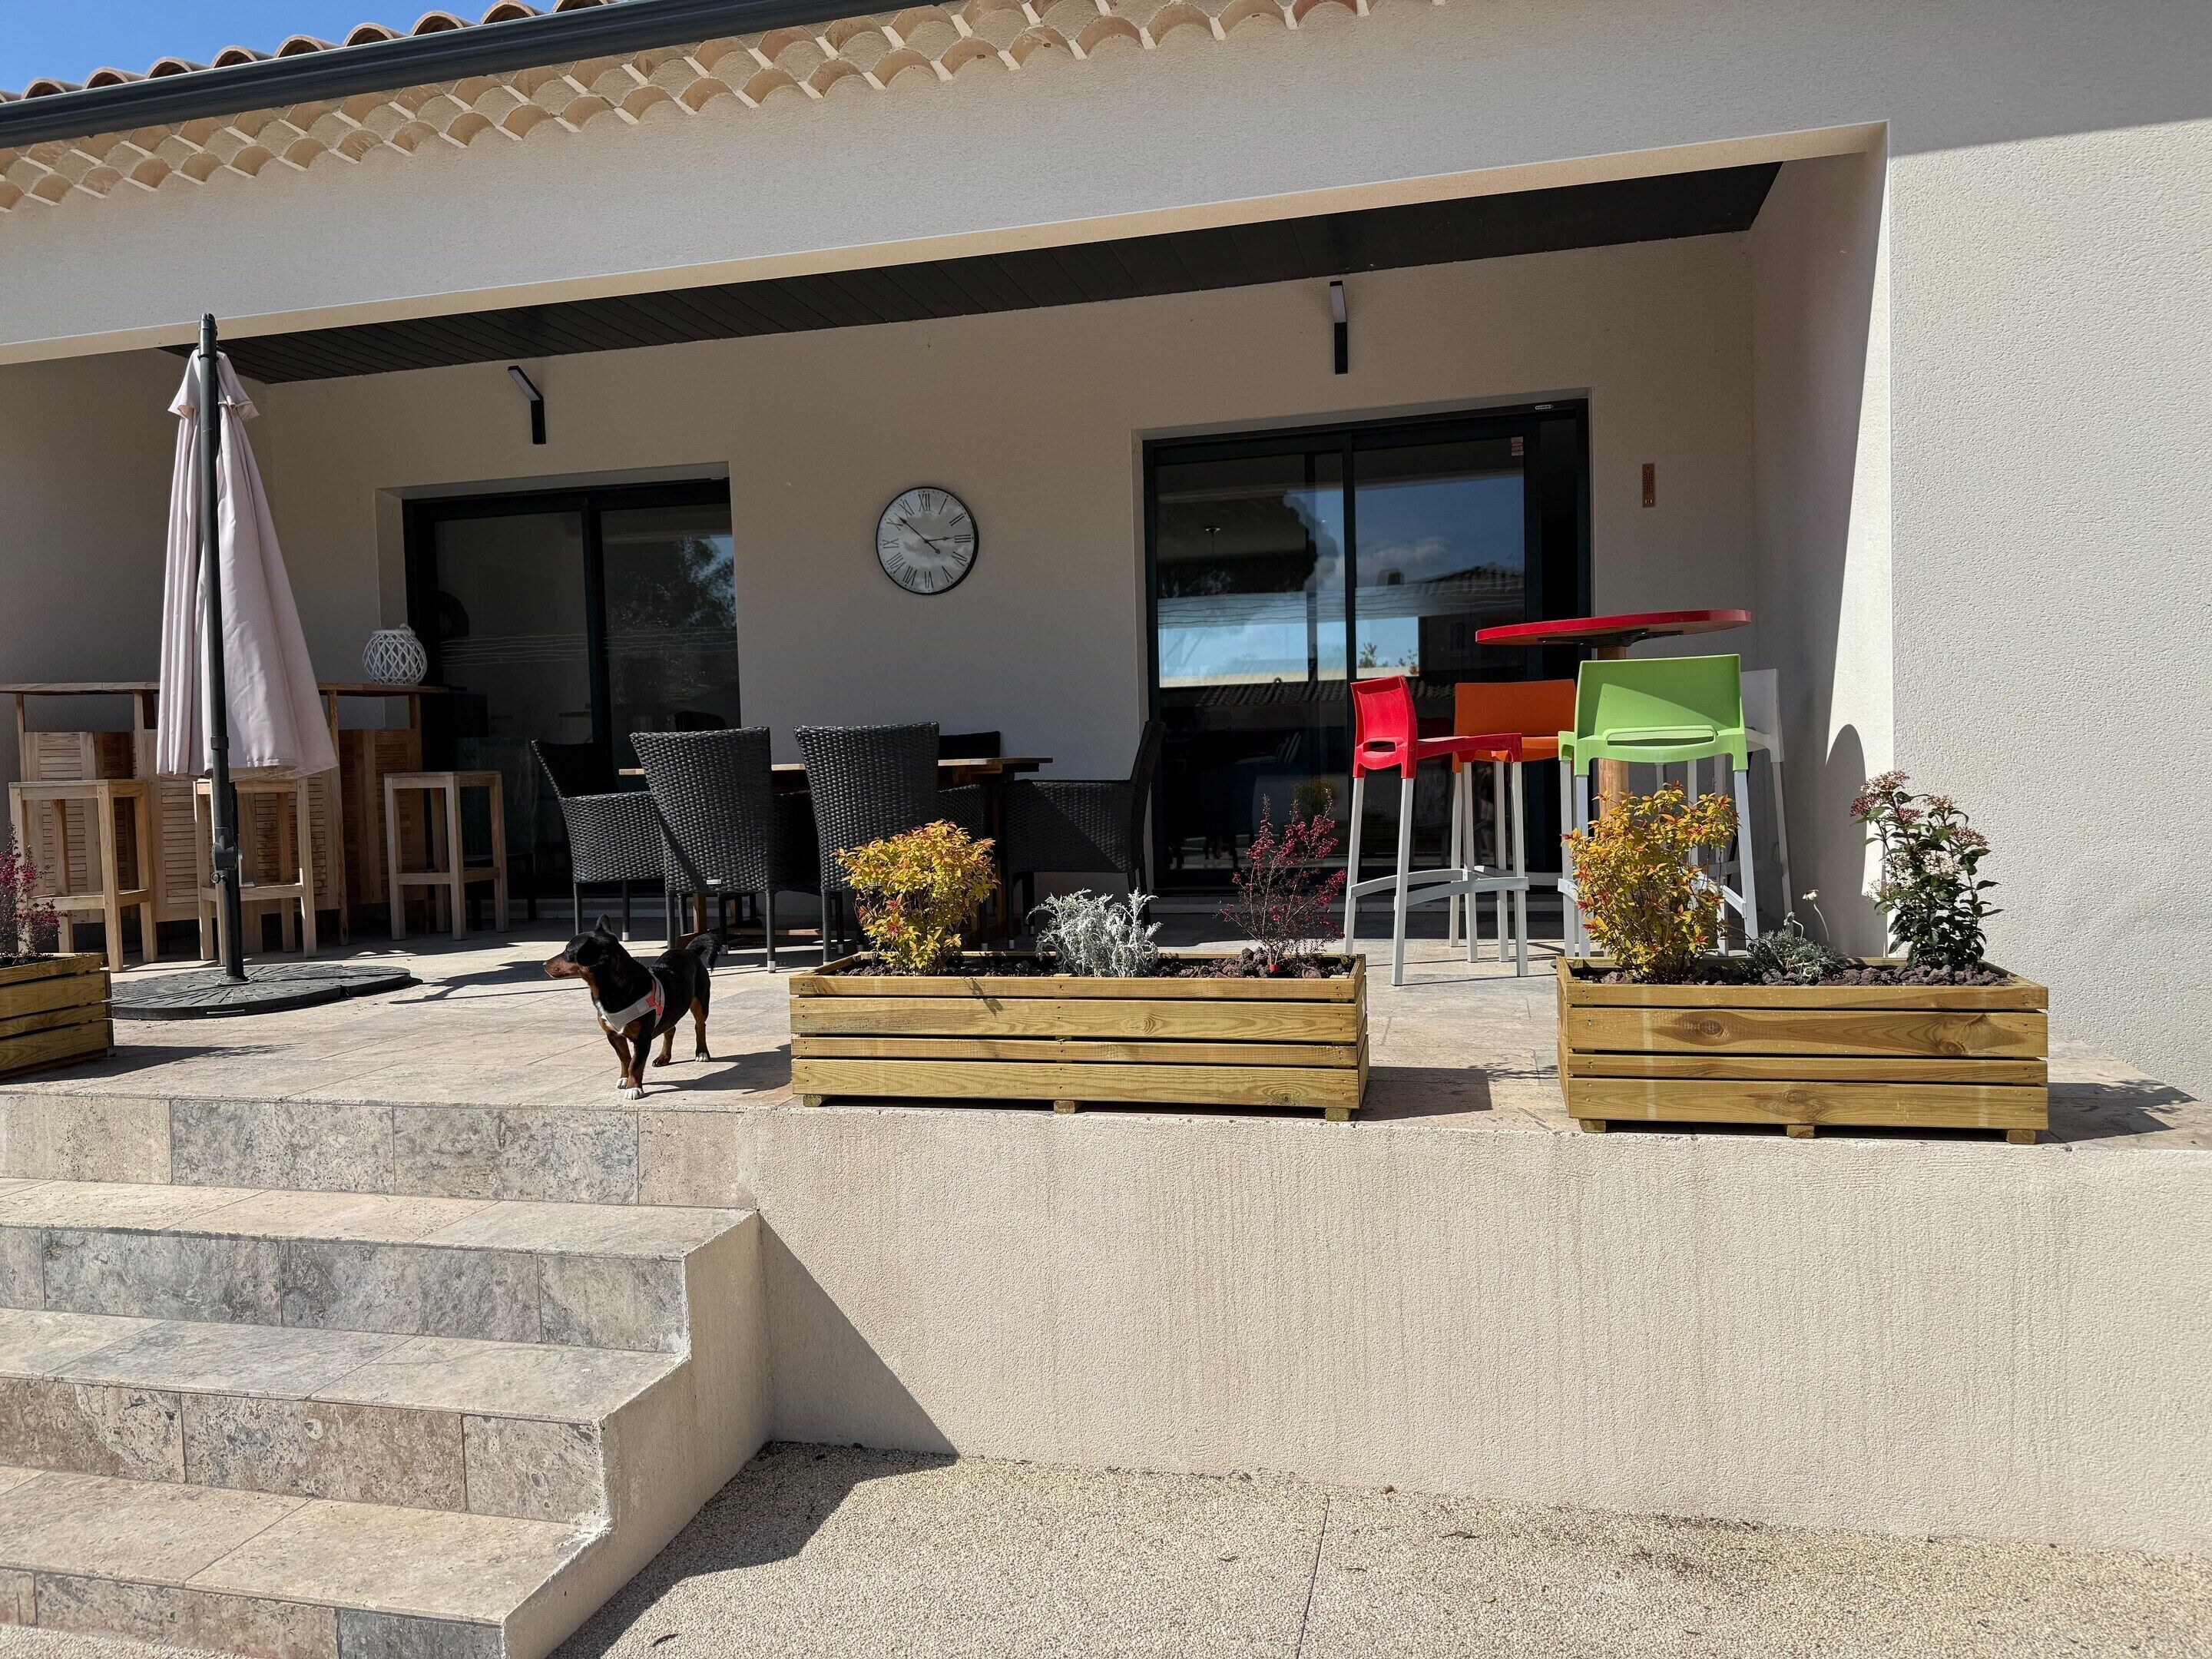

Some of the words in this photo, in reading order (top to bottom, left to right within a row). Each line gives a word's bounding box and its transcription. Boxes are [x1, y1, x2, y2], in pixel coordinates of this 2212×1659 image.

[899, 499, 914, 518] XI
[919, 494, 930, 512] XII
[939, 498, 947, 515] I
[886, 518, 903, 531] X
[949, 513, 964, 525] II
[882, 538, 899, 548] IX
[902, 566, 917, 586] VII
[925, 571, 934, 588] VI
[942, 566, 953, 583] V
